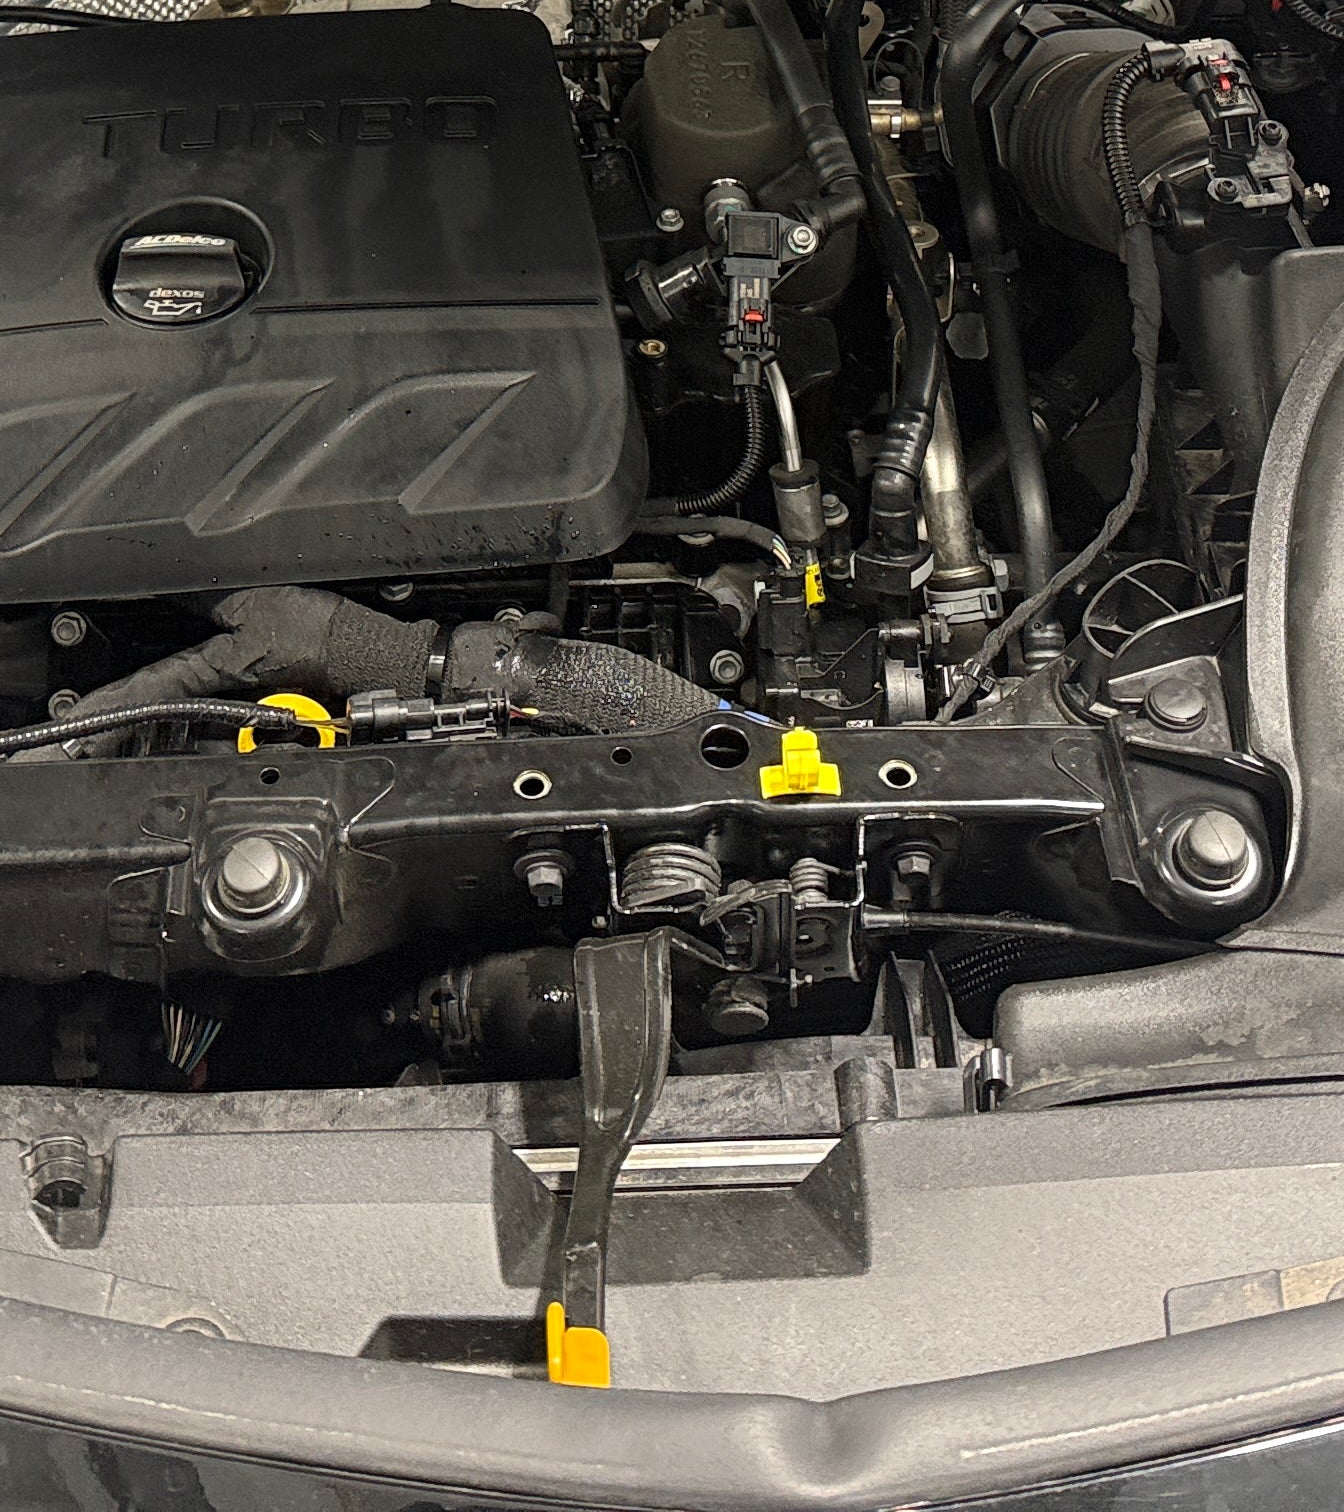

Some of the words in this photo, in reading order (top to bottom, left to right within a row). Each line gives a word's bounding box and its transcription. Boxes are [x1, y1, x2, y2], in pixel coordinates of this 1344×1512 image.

[81, 95, 498, 159] TURBO
[134, 234, 227, 247] ACDelco
[149, 287, 206, 299] dexos
